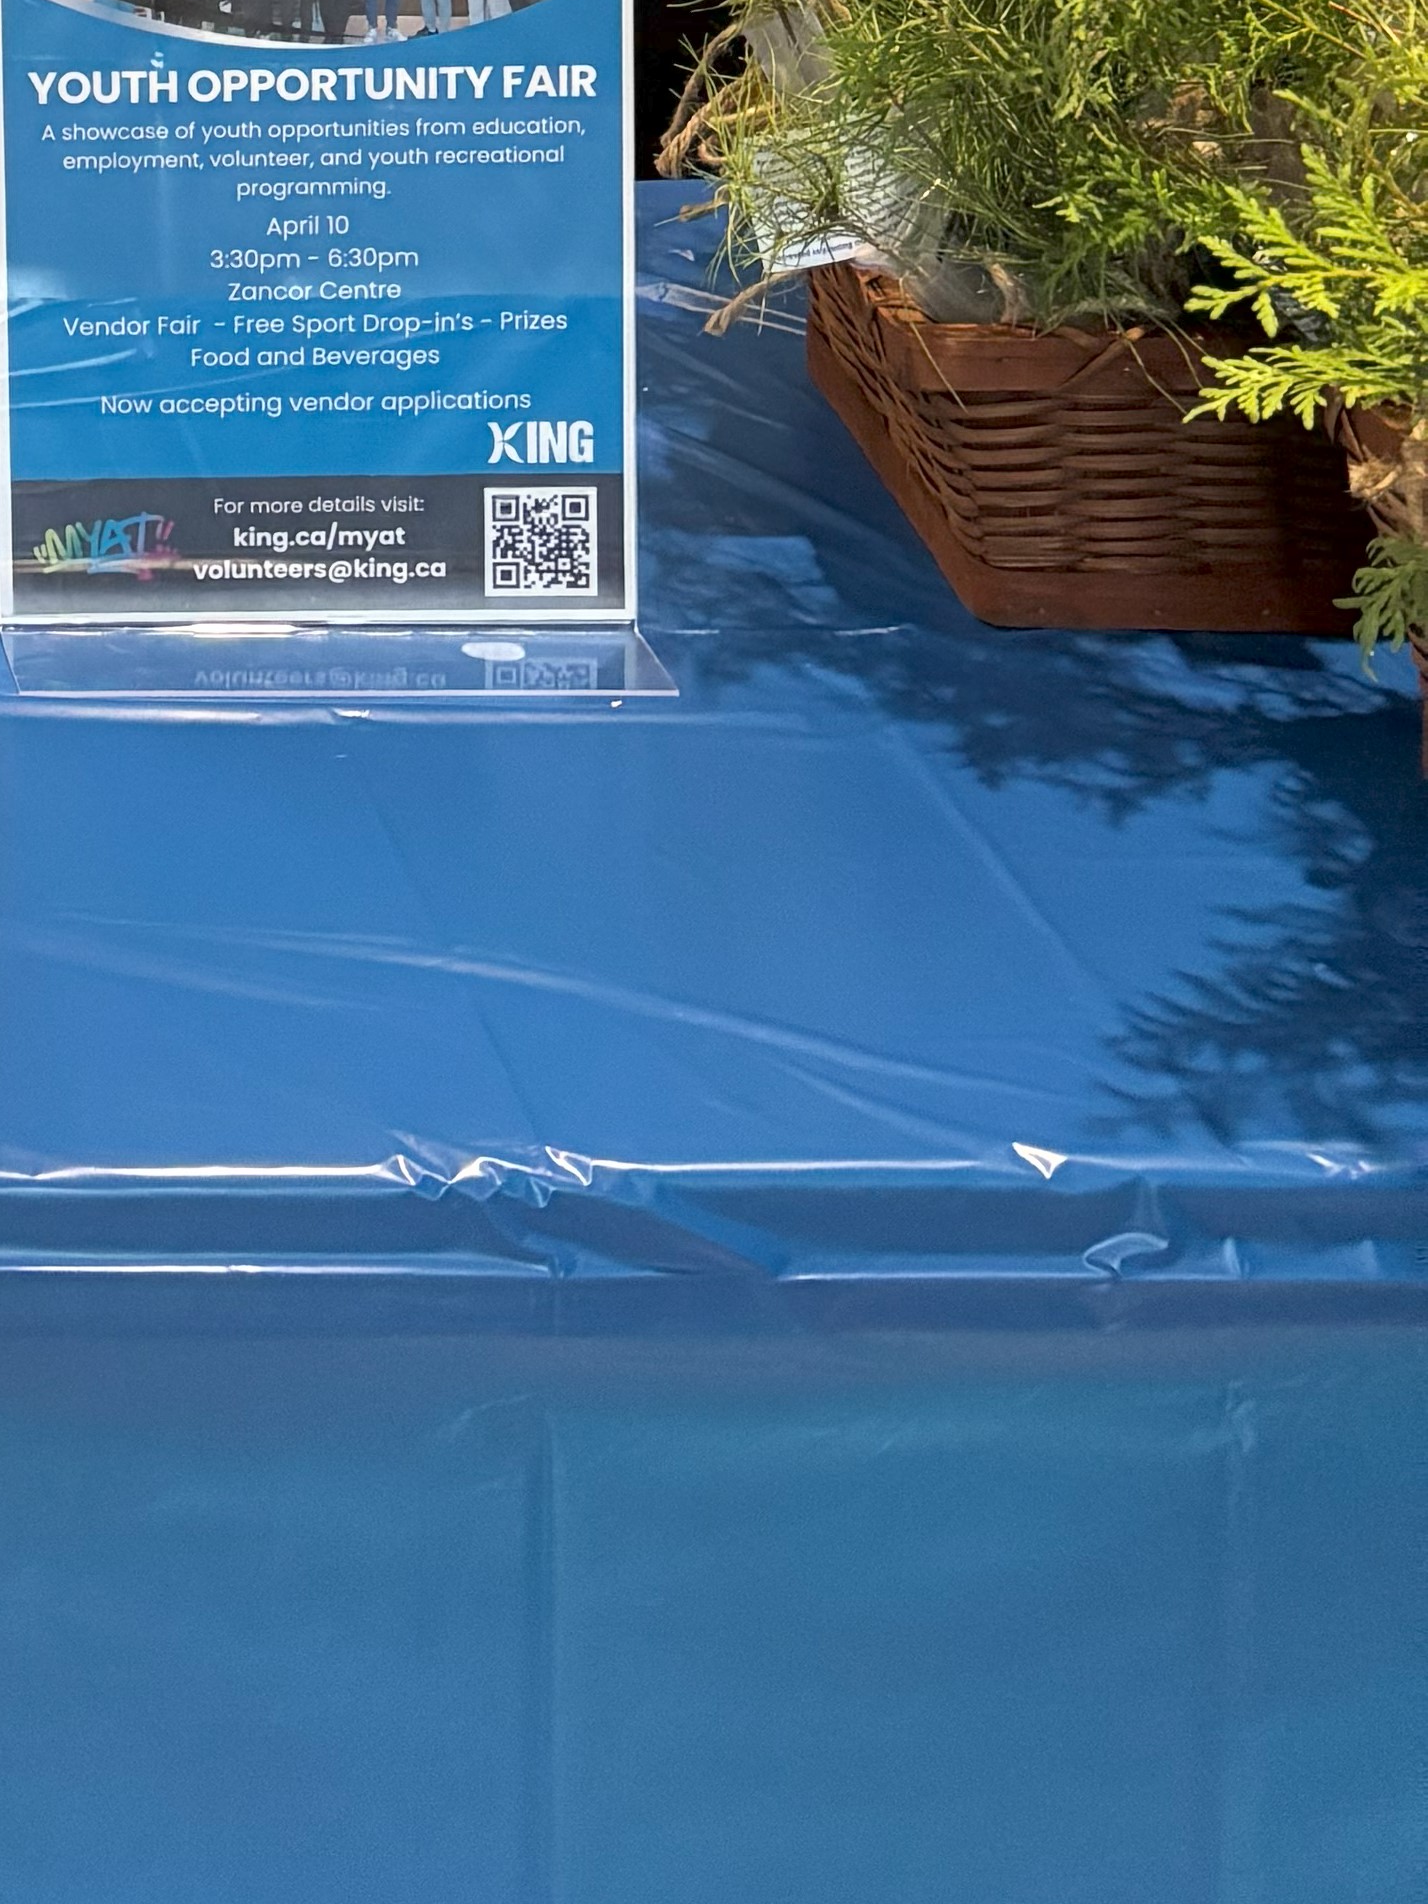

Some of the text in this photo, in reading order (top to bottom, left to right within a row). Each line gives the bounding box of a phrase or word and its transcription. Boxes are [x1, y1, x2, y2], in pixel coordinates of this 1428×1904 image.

[27, 64, 597, 105] YOUTH OPPORTUNITY FAIR
[41, 116, 585, 145] A showcase of youth opportunities from education,
[62, 145, 564, 174] employment, volunteer, and youth recreational
[236, 177, 392, 202] programming.
[266, 215, 350, 241] April 10
[210, 249, 301, 274] 3:30pm
[328, 247, 419, 273] 6:30pm
[228, 280, 402, 301] Zancor Centre
[63, 316, 151, 336] Vendor
[157, 315, 201, 335] Fair
[233, 315, 285, 334] Free
[291, 314, 356, 339] Sport
[500, 309, 568, 330] Prizes
[191, 346, 440, 371] Food and Beverages
[100, 389, 532, 419] Now accepting vendor applications
[487, 420, 594, 464] KING
[214, 495, 425, 514] For more details visit:
[233, 521, 406, 553] king.ca/myat
[192, 557, 446, 585] volunteers@king.ca
